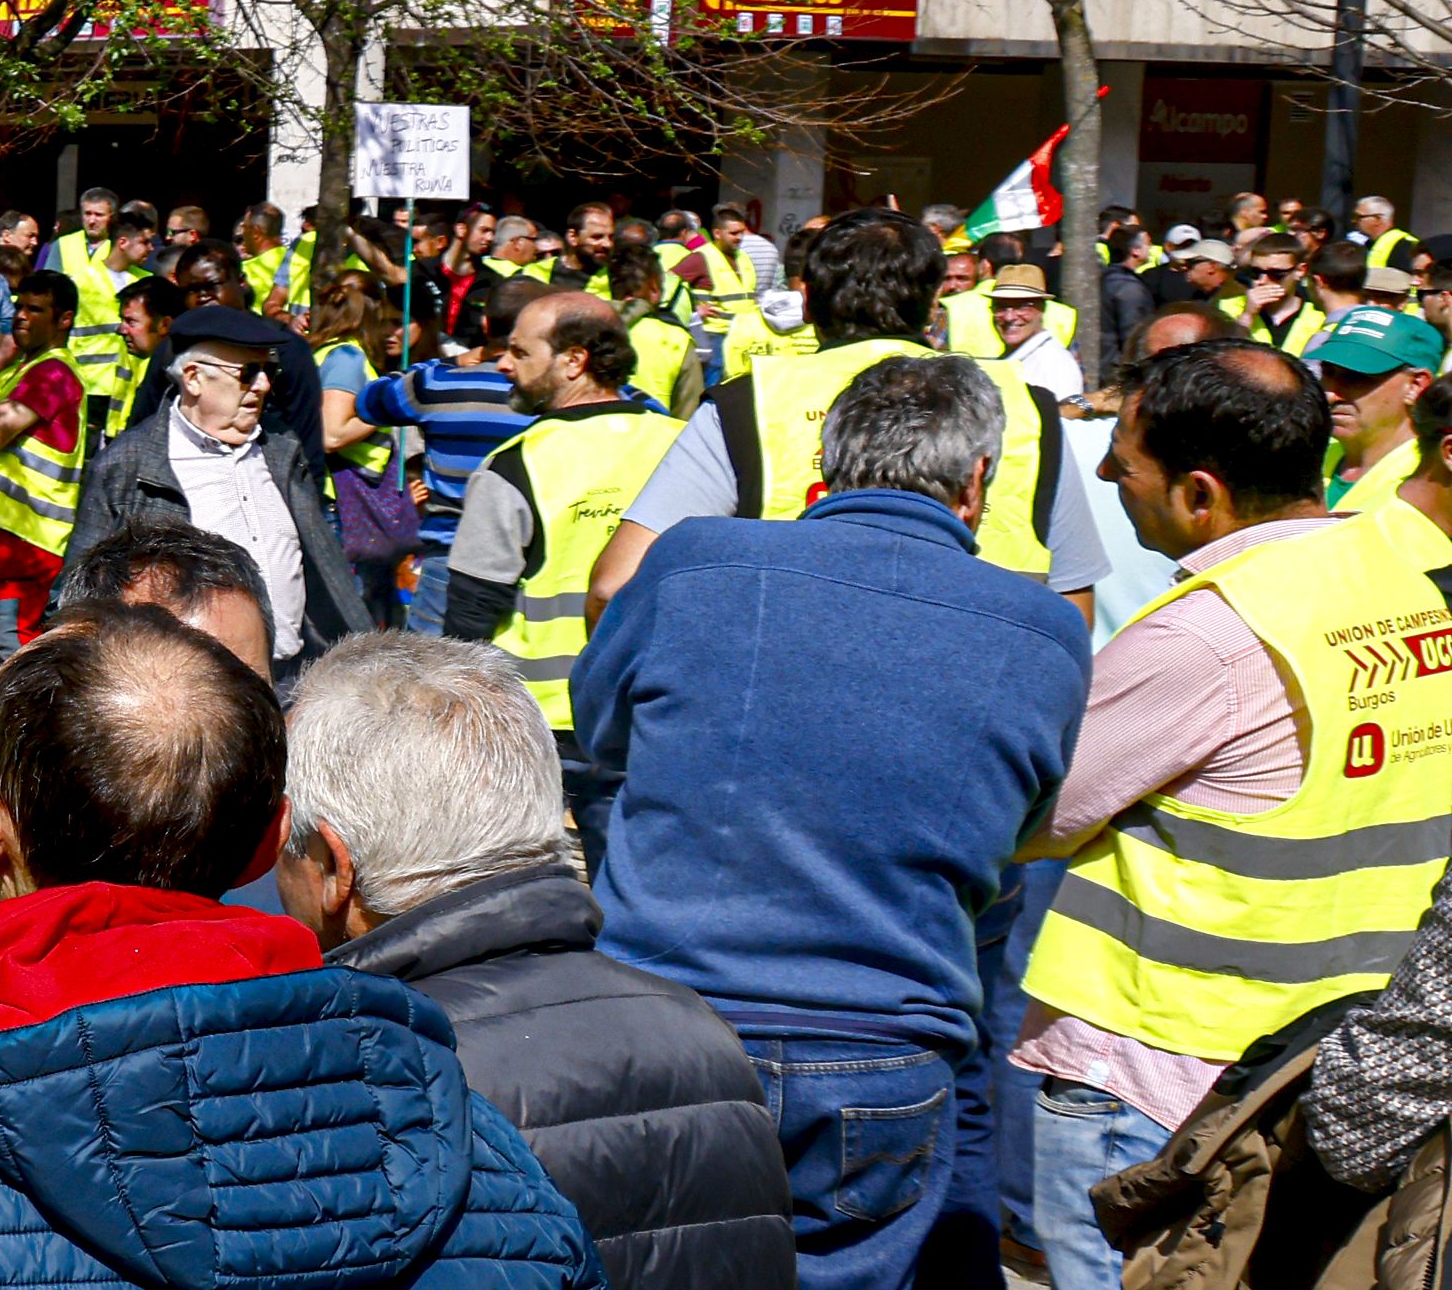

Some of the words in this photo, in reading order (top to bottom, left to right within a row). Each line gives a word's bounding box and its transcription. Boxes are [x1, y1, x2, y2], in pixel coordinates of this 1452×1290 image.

[1149, 98, 1248, 138] Alcampo
[568, 500, 624, 524] Treviño
[1324, 623, 1375, 647] UNION
[1377, 618, 1396, 636] DE
[1348, 690, 1396, 711] Burgos
[1391, 725, 1425, 748] Unión
[1427, 722, 1442, 740] de
